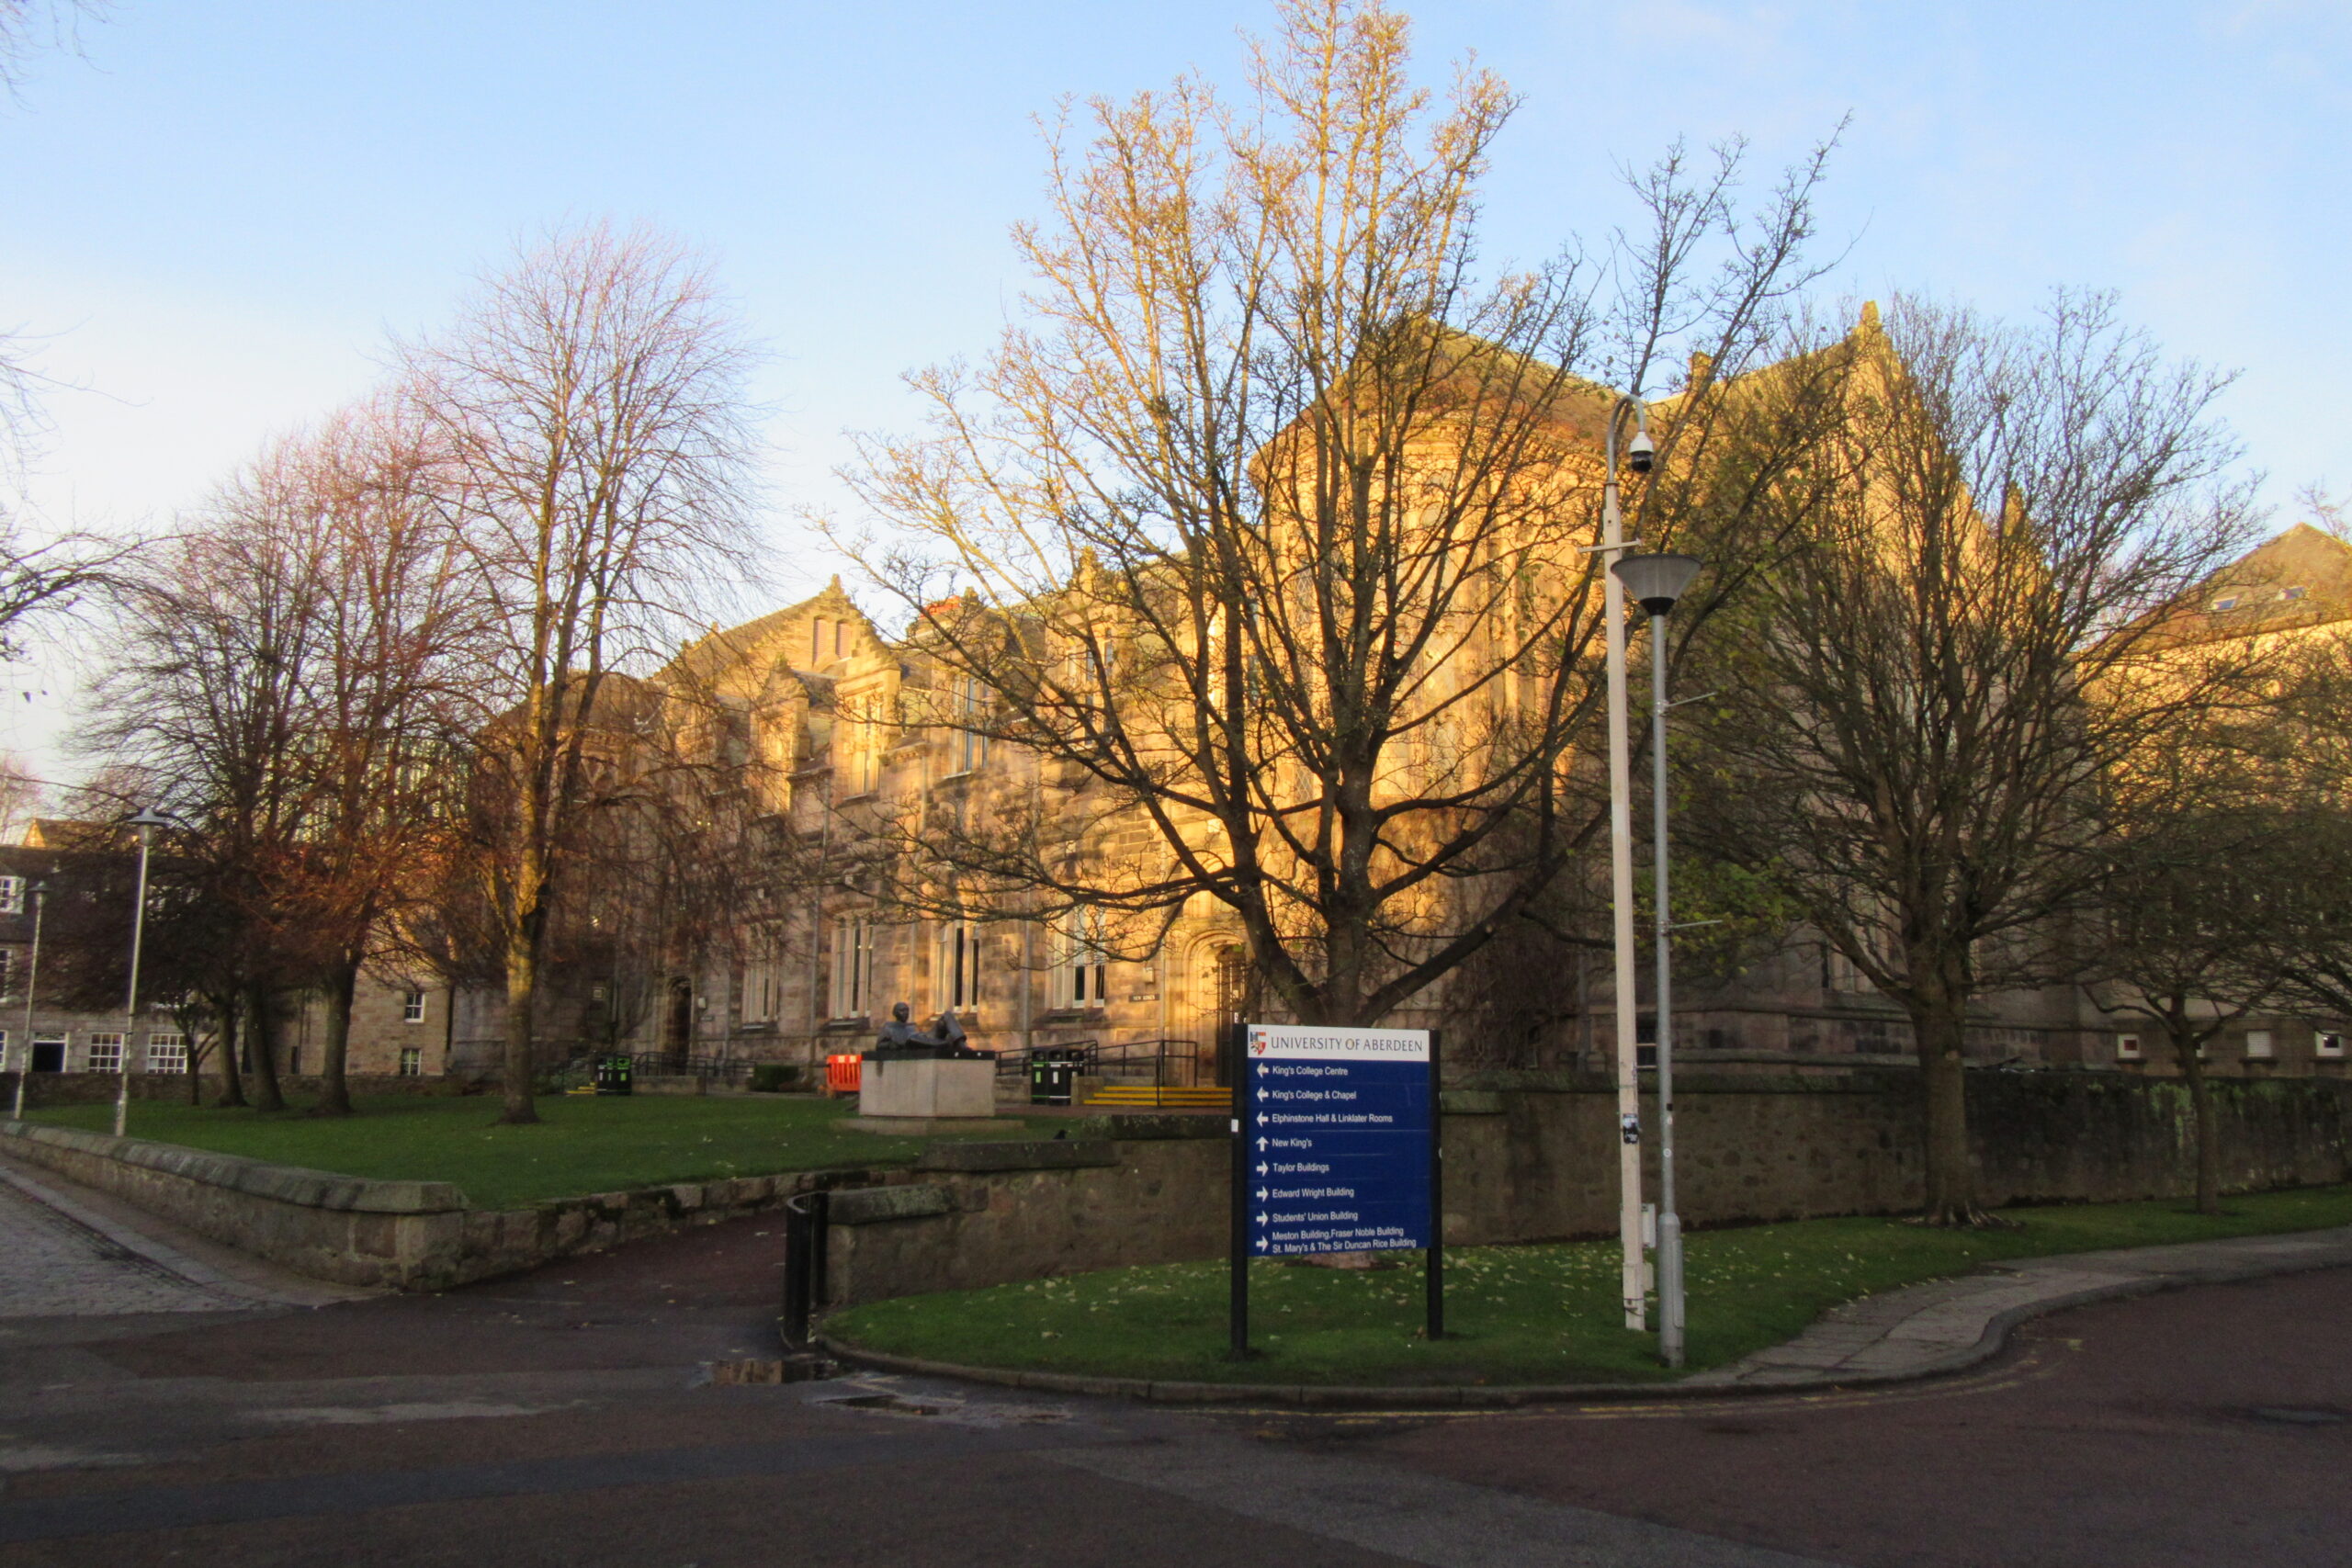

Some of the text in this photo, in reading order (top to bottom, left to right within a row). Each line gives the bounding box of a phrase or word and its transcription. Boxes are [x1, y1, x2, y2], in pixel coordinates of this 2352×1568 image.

[1272, 1037, 1423, 1052] UNIVERSITY OF ABERDEEN
[1272, 1066, 1348, 1077] King's College Centre
[1272, 1090, 1356, 1100] King's College & Chapel
[1272, 1113, 1393, 1124] Elphinstone Hall & Linklater Rooms
[1272, 1138, 1312, 1149] New King's
[1273, 1163, 1329, 1174] Taylor Buildings
[1272, 1187, 1354, 1199] Edward Wright Building
[1272, 1211, 1358, 1223] Students' Union Building
[1272, 1231, 1299, 1241] Meston
[1355, 1227, 1375, 1236] Noble
[1377, 1226, 1403, 1236] Building
[1272, 1237, 1416, 1255] St. Mary's & The Sir Duncan Rice Building
